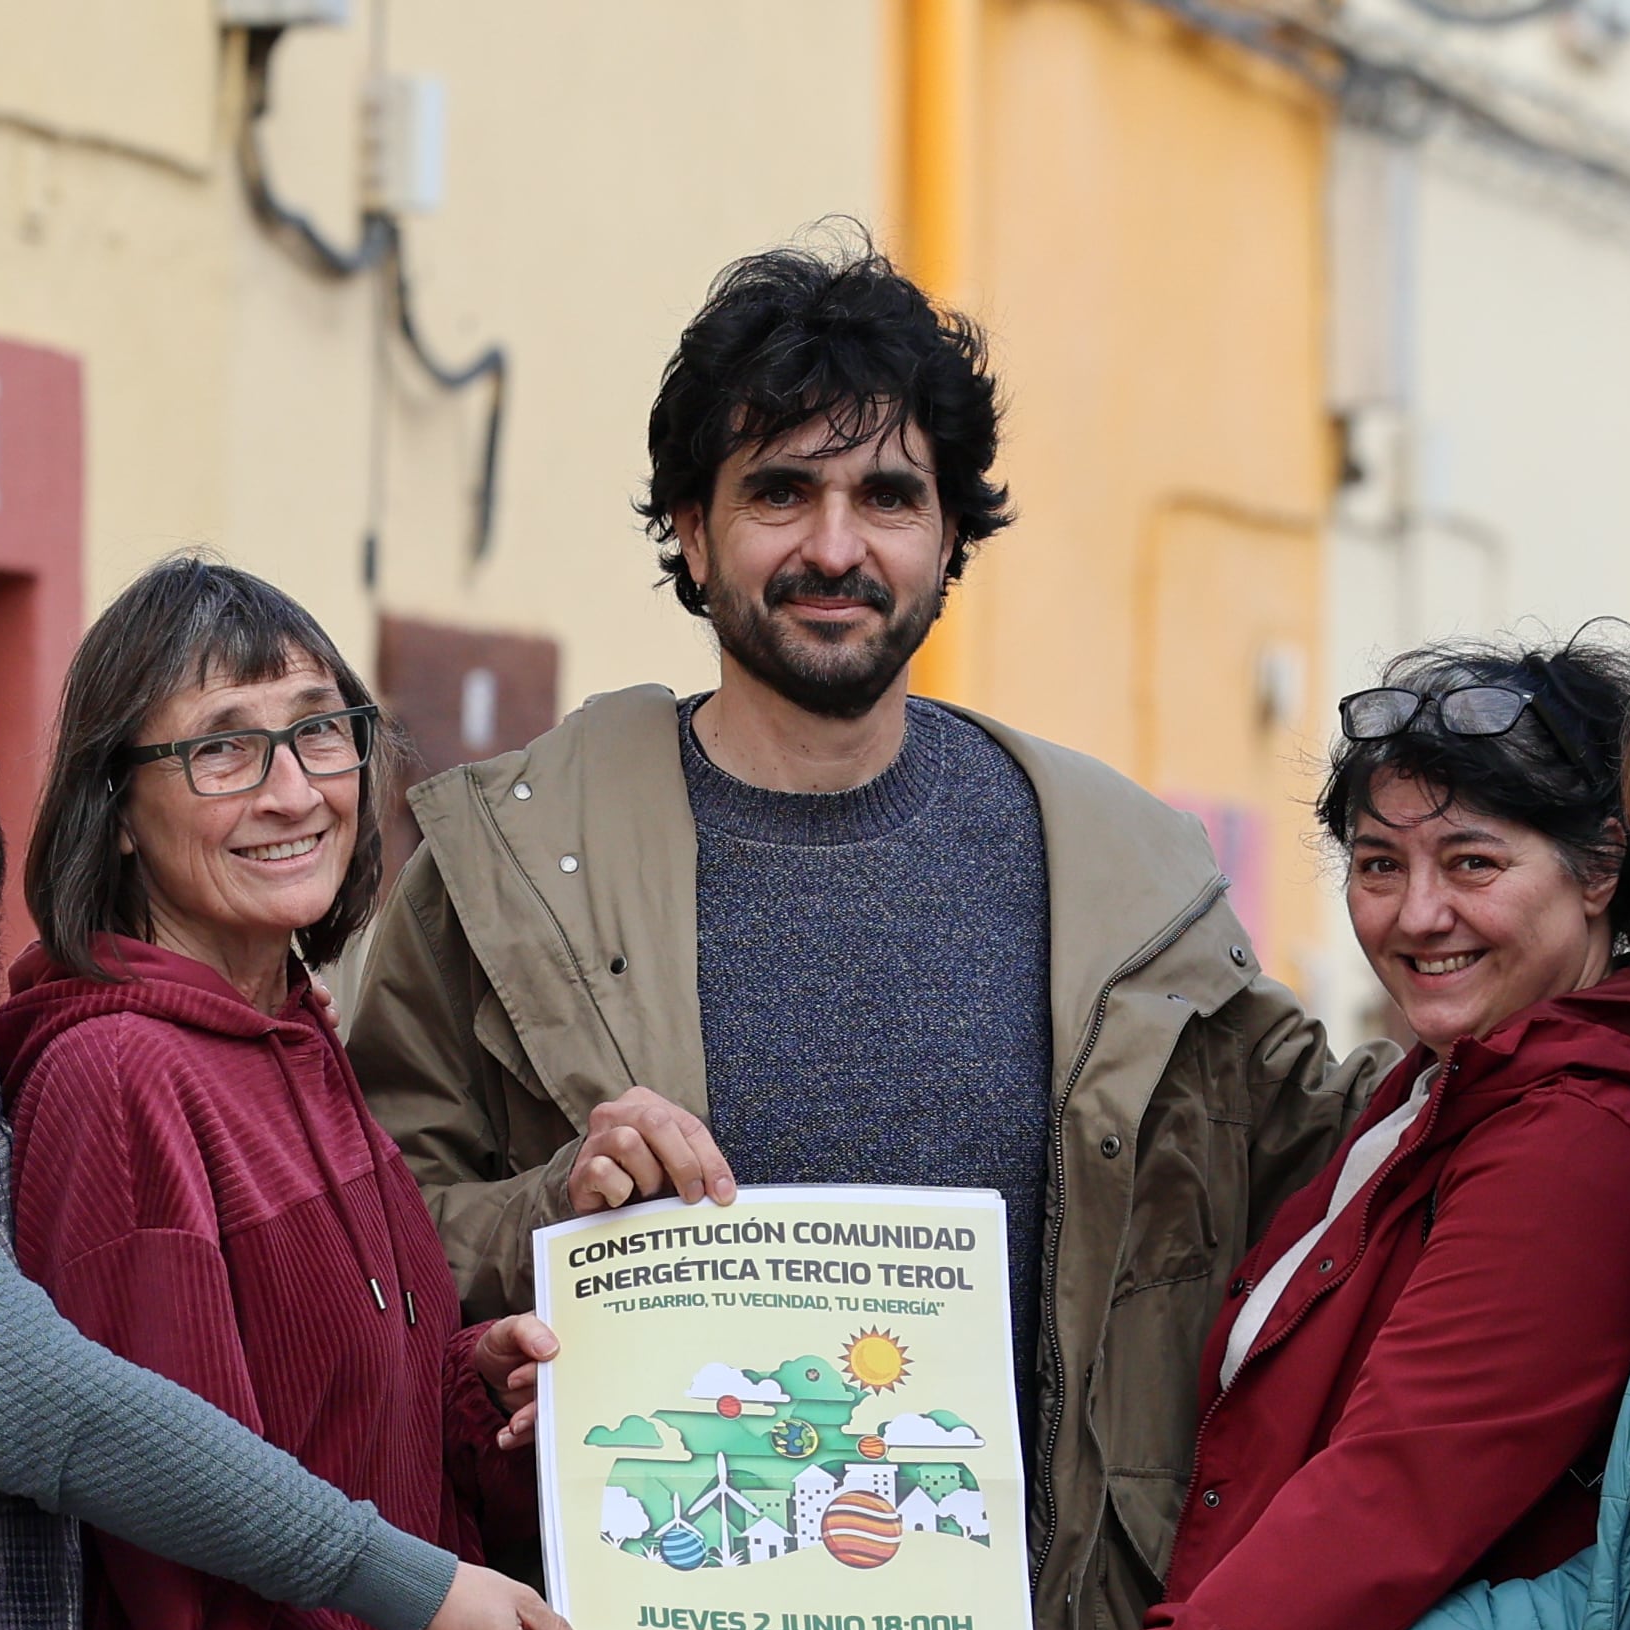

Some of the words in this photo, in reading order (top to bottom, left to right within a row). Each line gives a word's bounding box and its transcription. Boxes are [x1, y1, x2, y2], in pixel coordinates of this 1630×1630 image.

[569, 1217, 785, 1268] CONSTITUCIÓN
[793, 1222, 976, 1251] COMUNIDAD
[575, 1256, 760, 1299] ENERGÉTICA
[765, 1259, 871, 1285] TERCIO
[877, 1263, 974, 1291] TEROL
[603, 1299, 635, 1314] "TU
[639, 1293, 708, 1311] BARRIO,
[711, 1293, 736, 1307] TU
[739, 1293, 832, 1312] VECINDAD,
[835, 1296, 859, 1311] TU
[863, 1298, 945, 1316] ENERGÍA"
